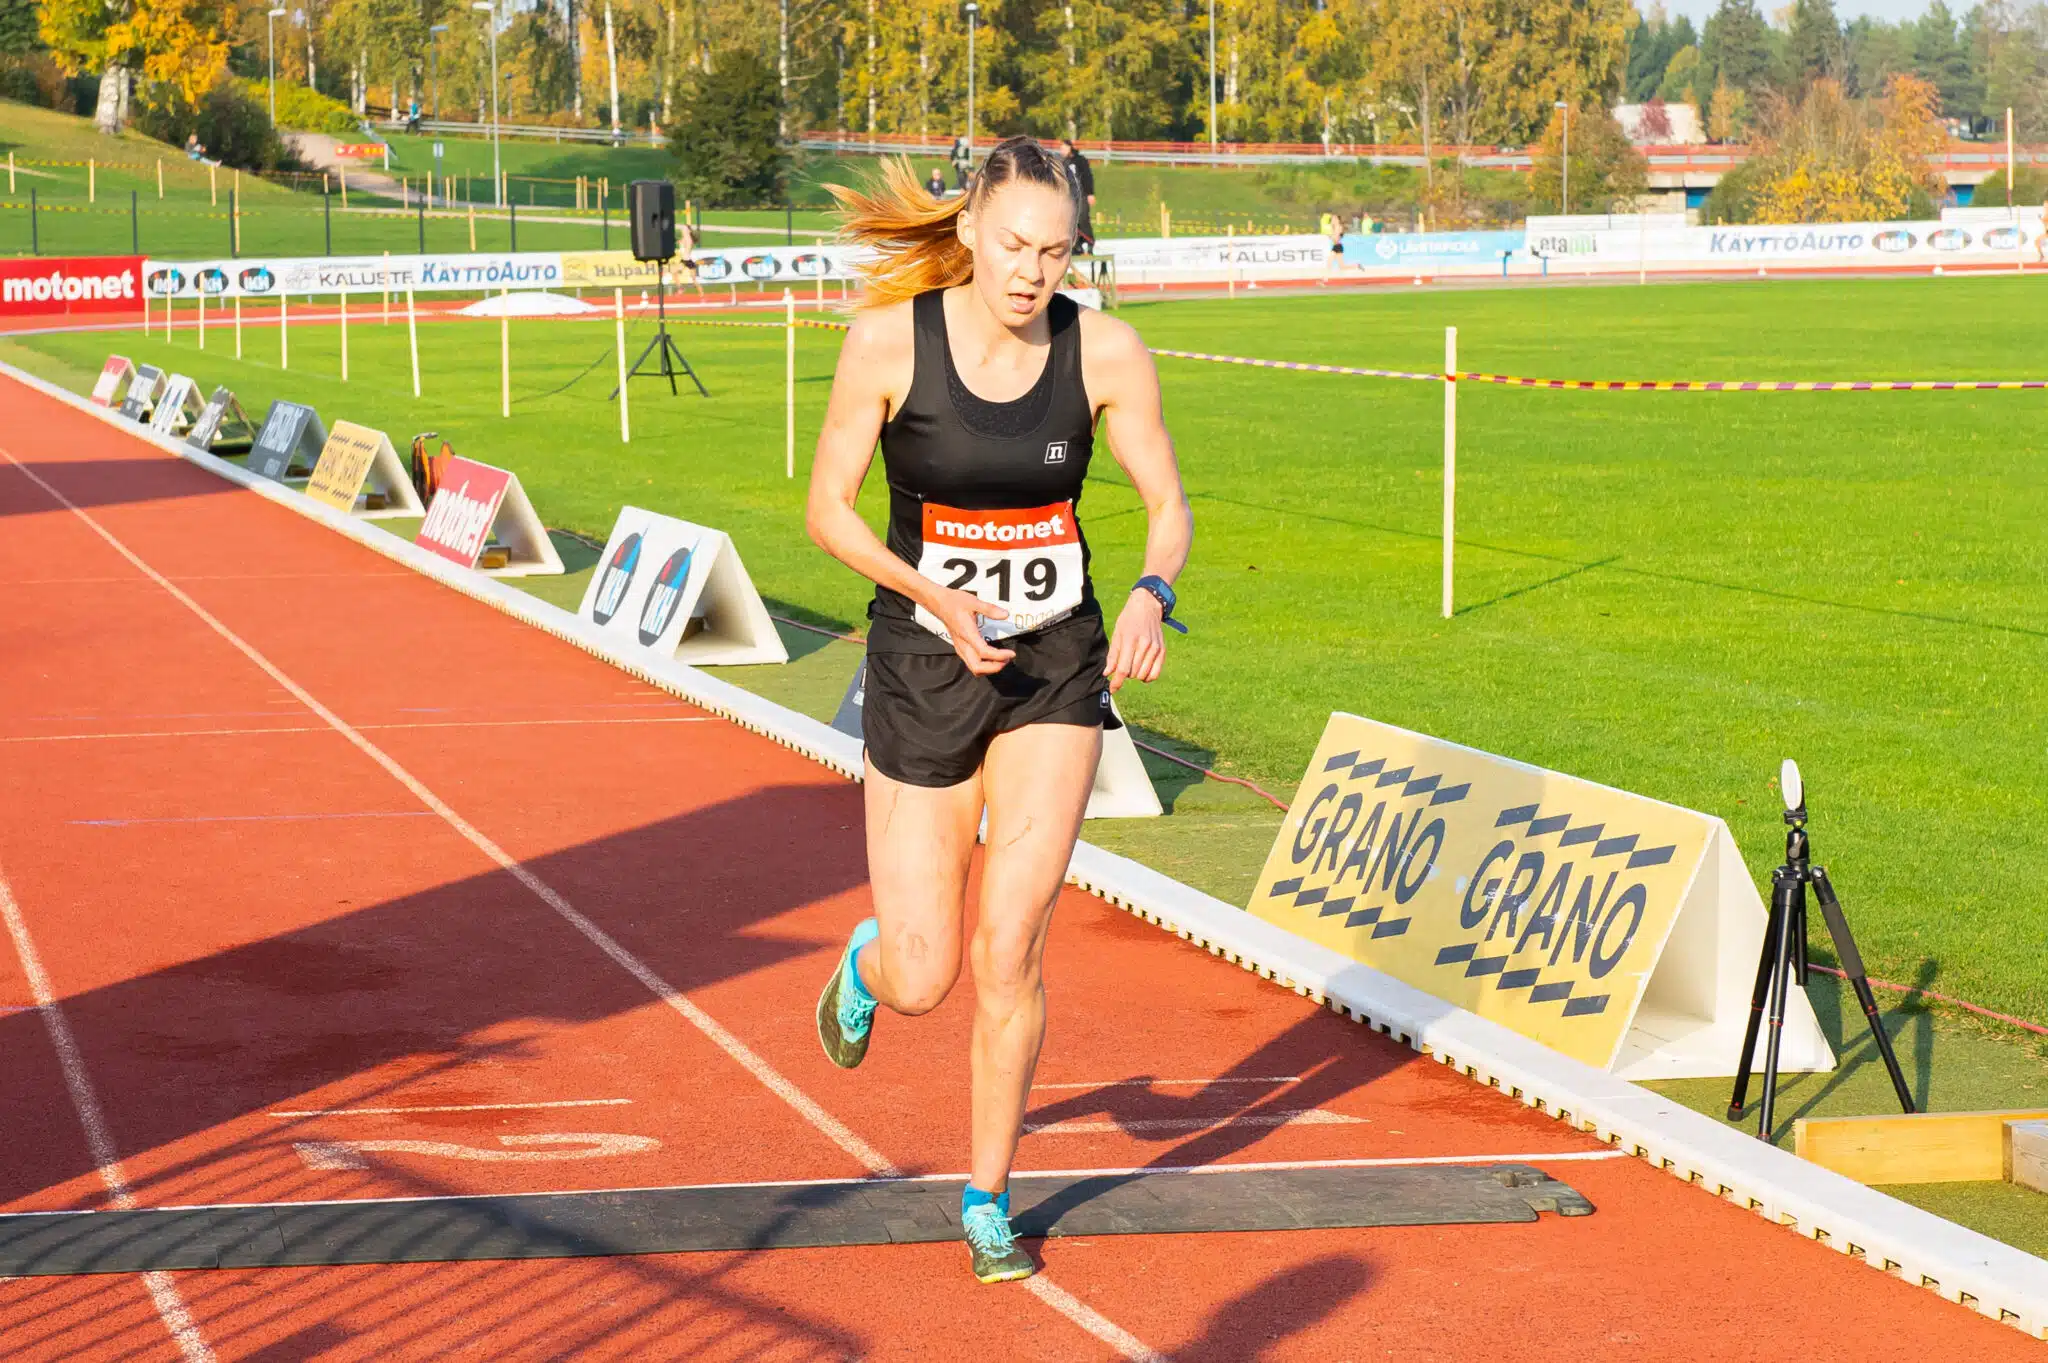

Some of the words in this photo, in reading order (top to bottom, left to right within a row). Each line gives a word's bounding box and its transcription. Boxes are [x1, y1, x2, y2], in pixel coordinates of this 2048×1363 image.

[1219, 249, 1324, 264] KALUSTE
[3, 269, 135, 302] motonet
[319, 270, 413, 287] KALUSTE
[420, 480, 500, 558] motonet
[935, 513, 1065, 542] motonet
[942, 557, 1058, 603] 219
[1291, 783, 1446, 905] GRANO
[1459, 840, 1648, 980] GRANO
